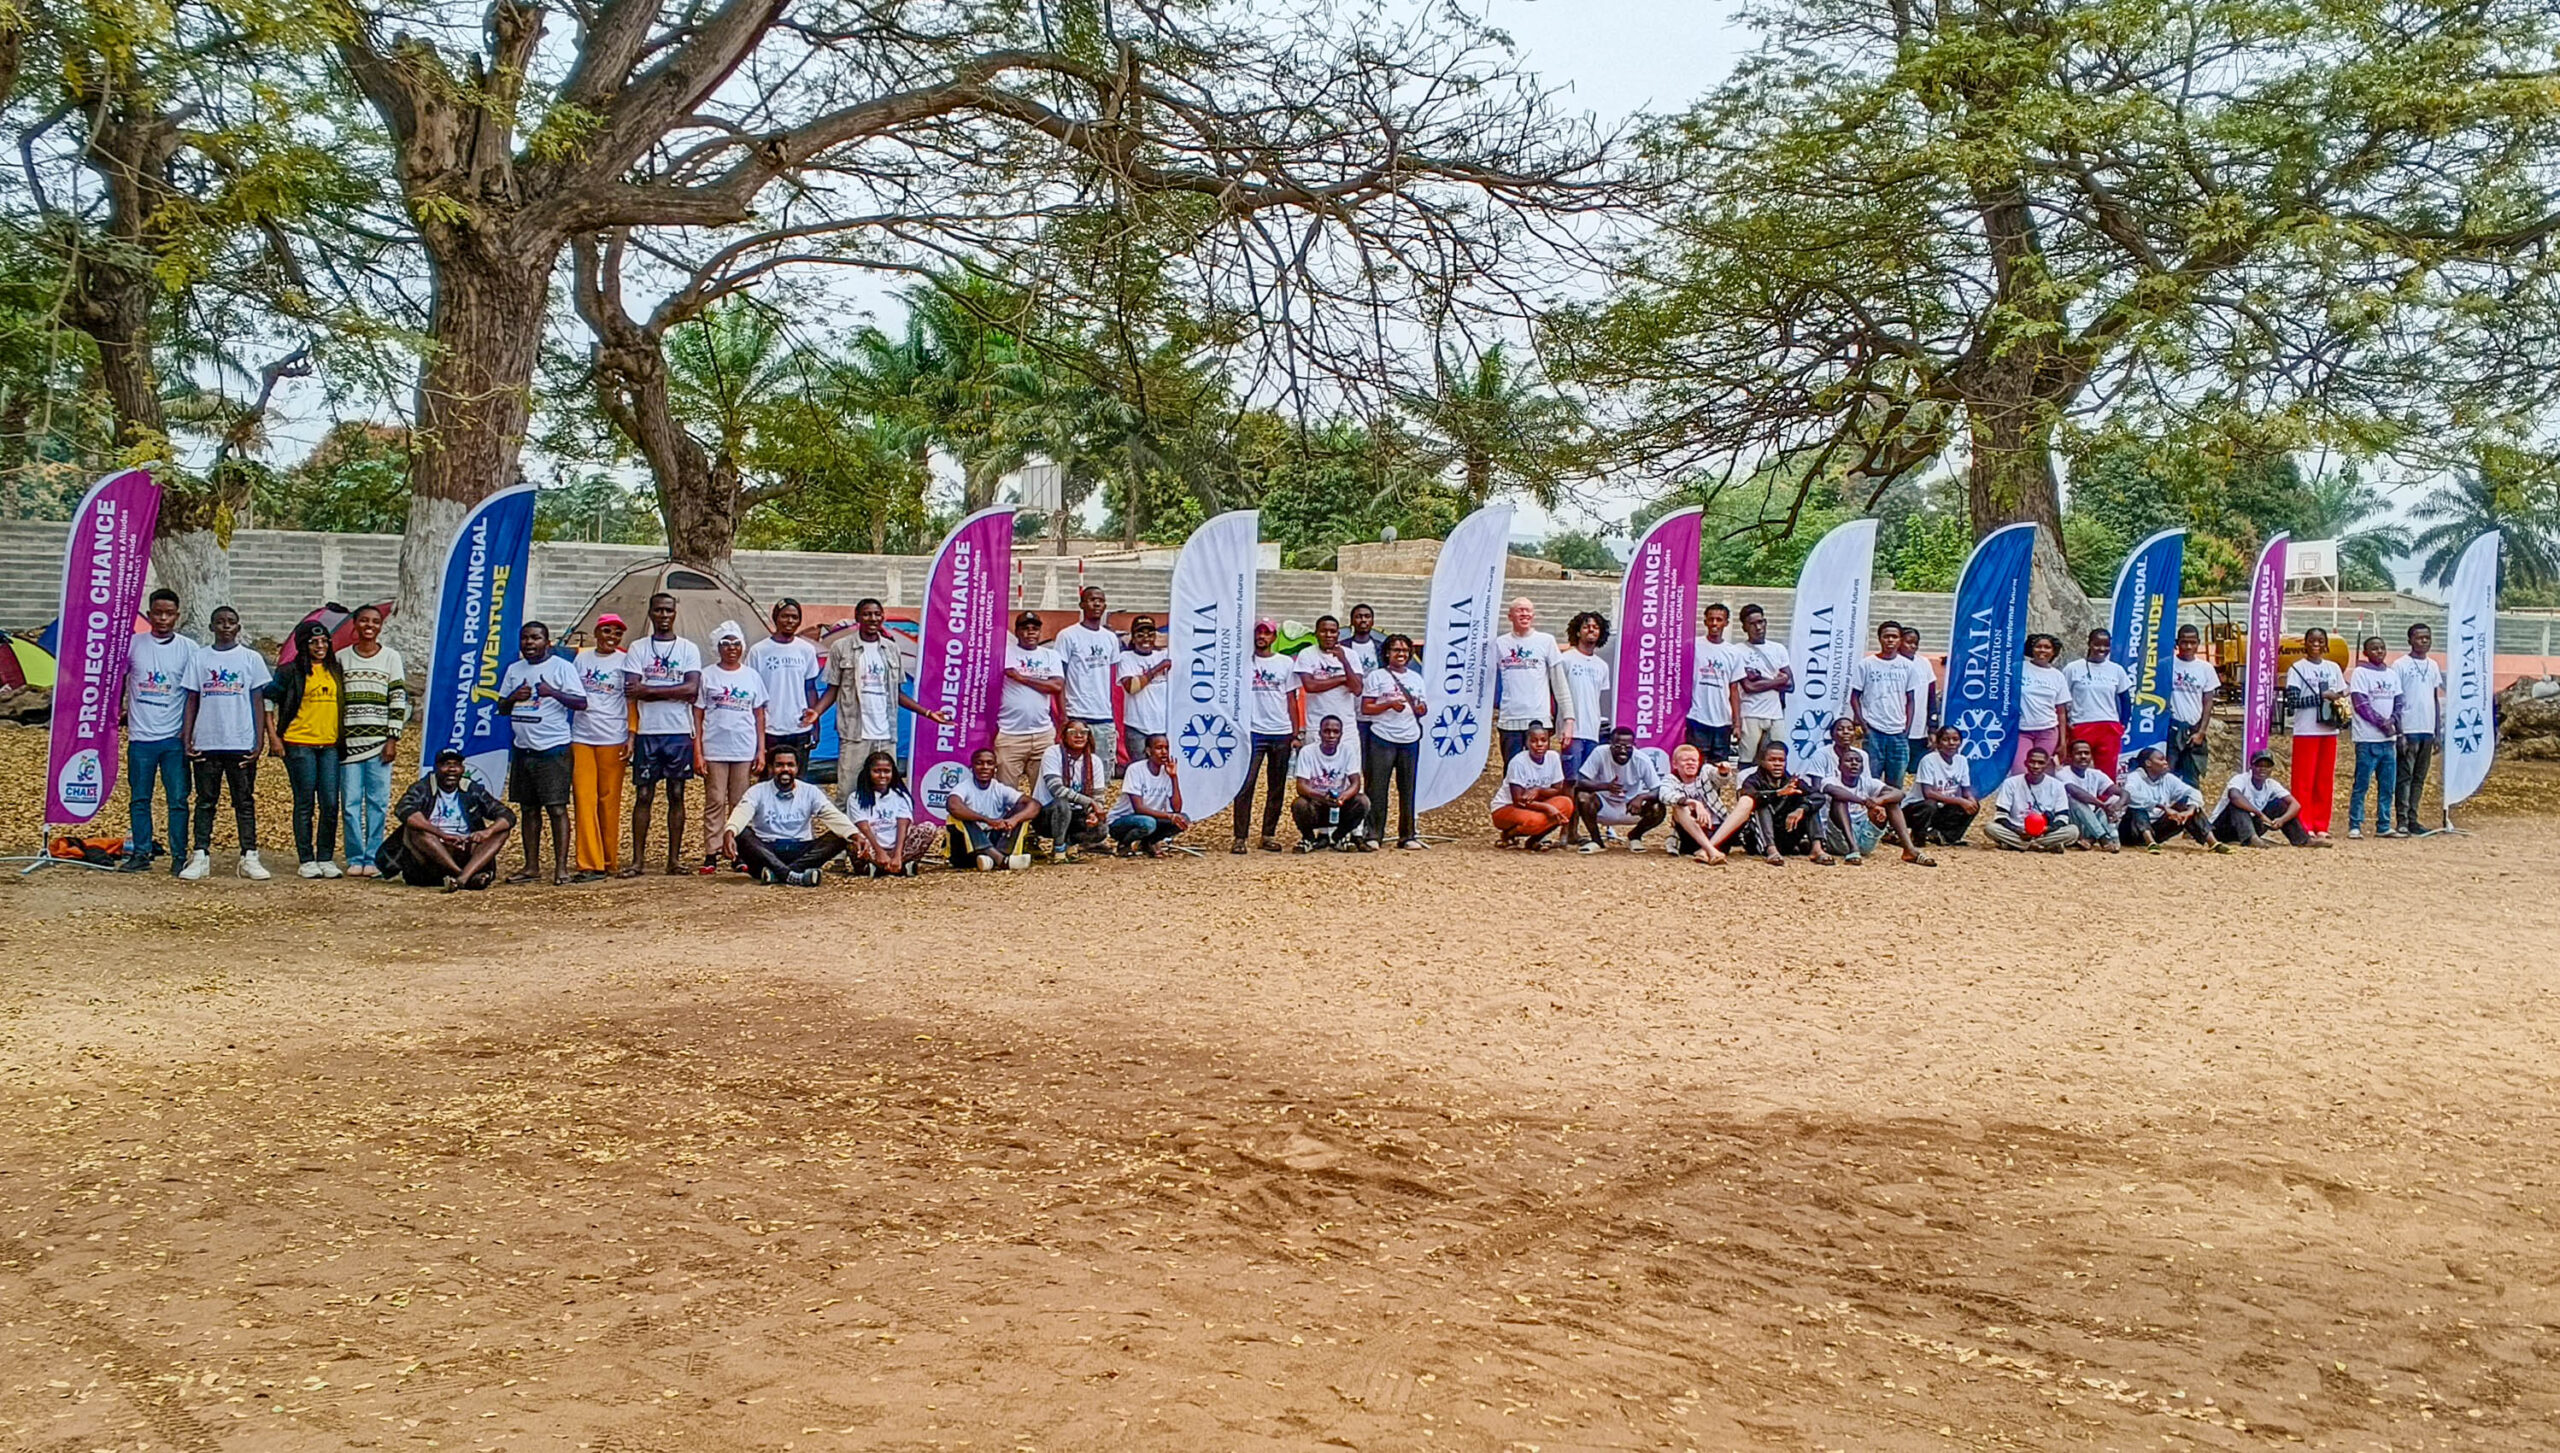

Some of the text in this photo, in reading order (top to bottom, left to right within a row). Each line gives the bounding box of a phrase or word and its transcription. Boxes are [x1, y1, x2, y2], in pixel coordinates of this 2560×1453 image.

[78, 499, 115, 738] PROJECTO CHANCE
[451, 516, 487, 750] JORNADA PROVINCIAL
[471, 564, 510, 735] DA JUVENTUDE
[936, 541, 970, 751] PROJECTO CHANCE
[1235, 602, 1243, 648] transformar
[1443, 594, 1472, 694] OPAIA
[1636, 542, 1661, 737] PROJECTO CHANCE
[1803, 604, 1833, 698] OPAIA
[2129, 555, 2147, 656] PROVINCIAL
[2260, 564, 2269, 641] CHANCE
[1188, 601, 1217, 702] OPAIA
[1219, 628, 1229, 703] FOUNDATION
[1232, 679, 1240, 721] Empoderar
[1465, 619, 1479, 693] FOUNDATION
[1830, 629, 1843, 699] FOUNDATION
[1962, 607, 1993, 699] OPAIA
[1989, 628, 2001, 699] FOUNDATION
[2136, 593, 2166, 732] DA JUVENTUDE
